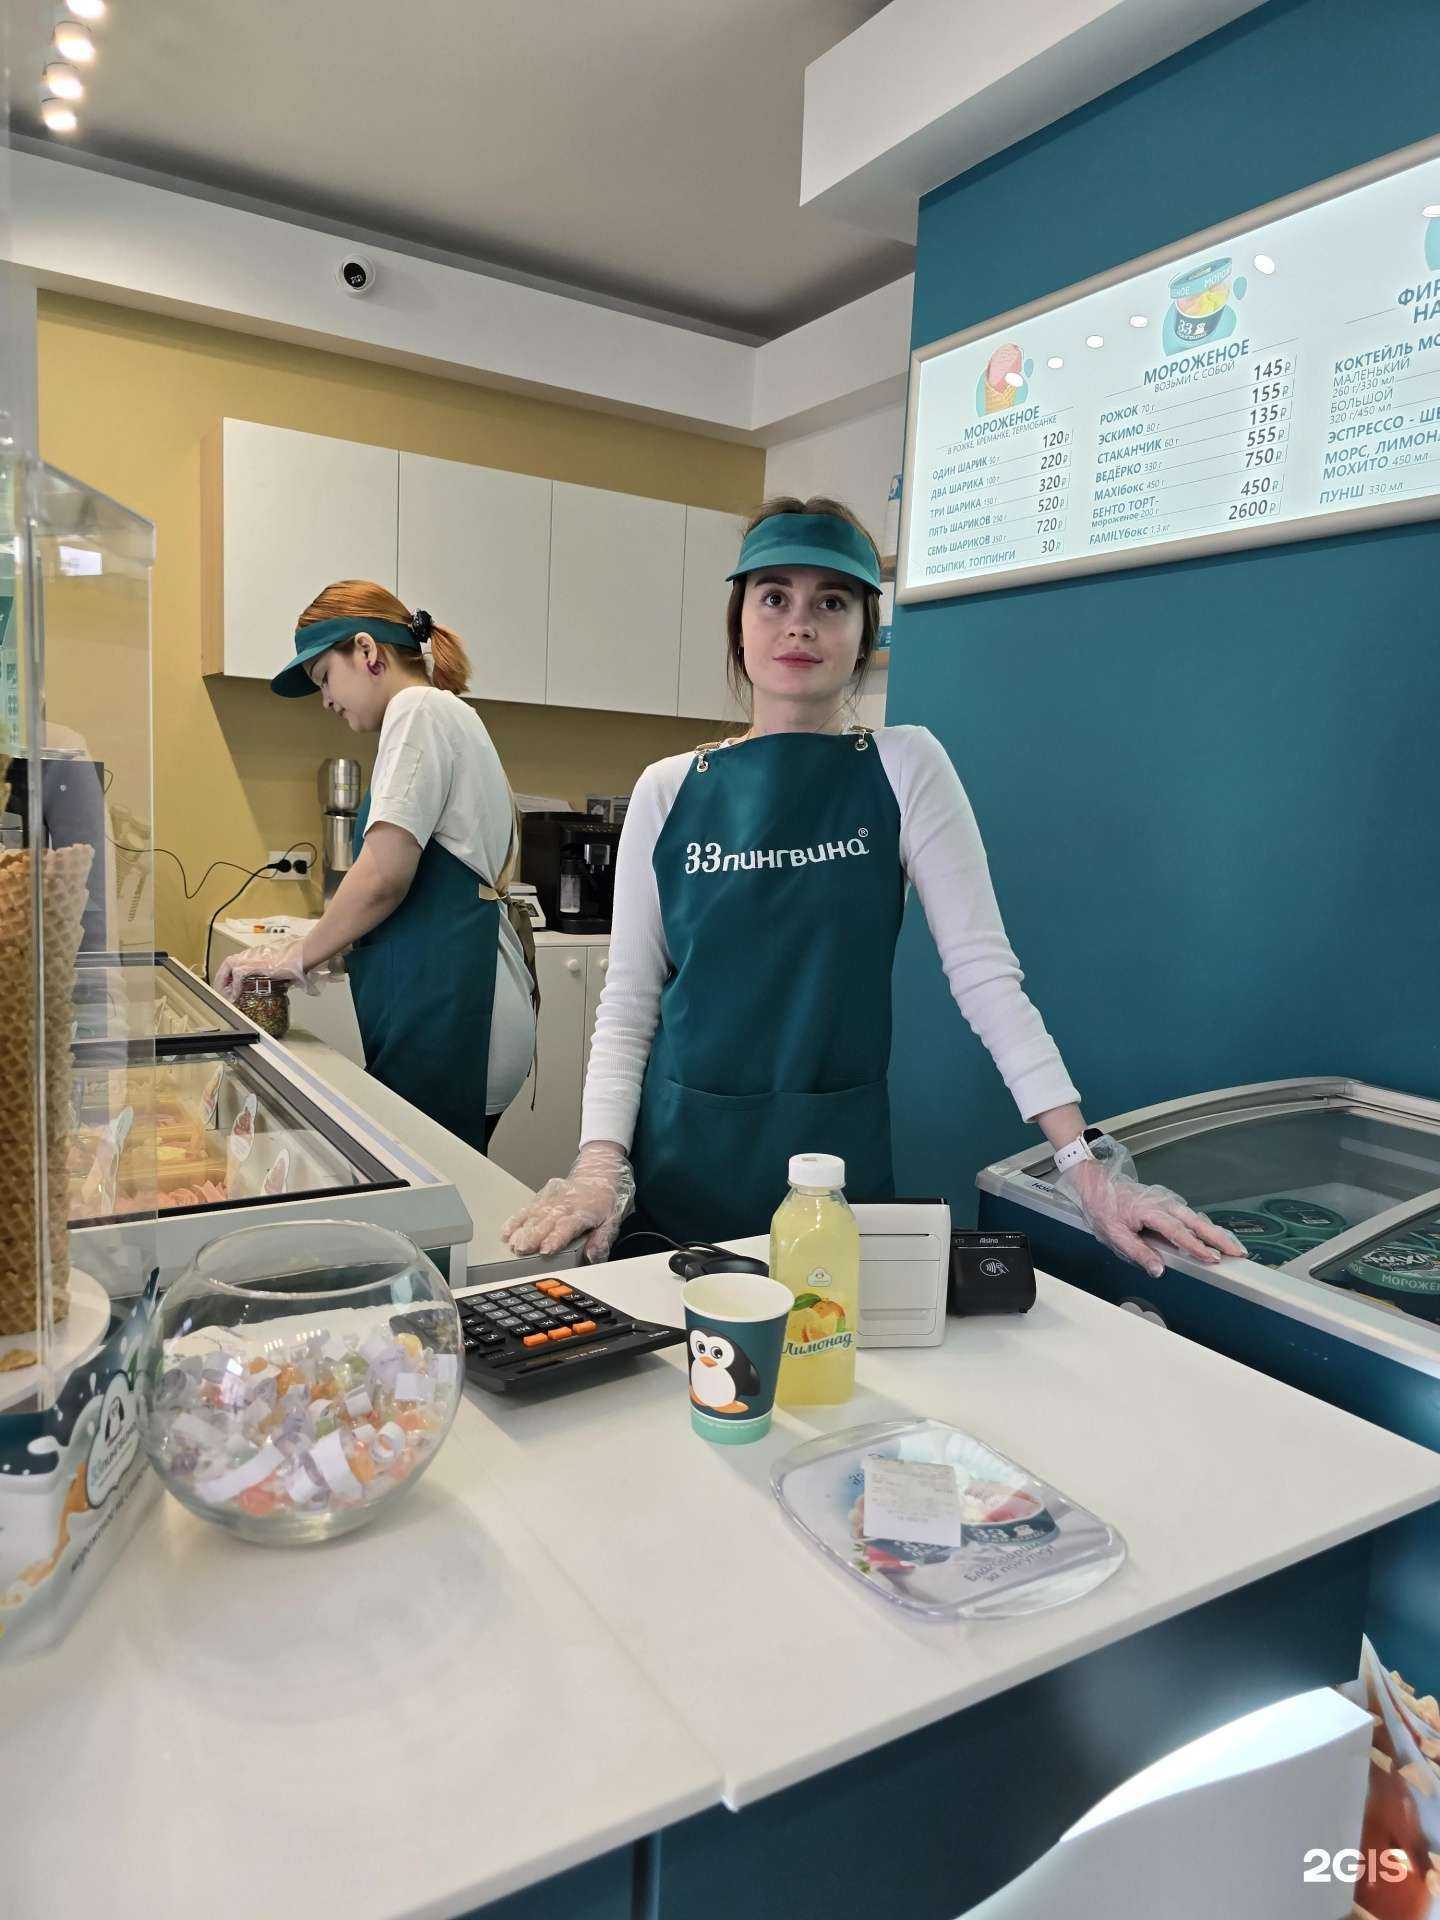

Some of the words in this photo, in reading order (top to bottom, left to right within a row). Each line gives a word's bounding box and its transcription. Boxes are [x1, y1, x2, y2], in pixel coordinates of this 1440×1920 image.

[1143, 338, 1250, 386] МОРОЖЕНОЕ
[1335, 342, 1413, 374] КОКТЕЙЛЬ
[1154, 376, 1191, 393] ВОЗЬМИ
[1202, 360, 1235, 378] СОБОЙ
[1333, 356, 1410, 387] МАЛЕНЬКИЙ
[1332, 384, 1350, 398] 260
[1381, 375, 1395, 386] мл
[1330, 388, 1393, 414] БОЛЬШОЙ
[964, 406, 1040, 440] МОРОЖЕНОЕ
[1100, 405, 1138, 425] РОЖОК
[1329, 412, 1347, 424] 320
[1378, 403, 1392, 412] мл
[1098, 424, 1144, 445] ЭСКИМО
[1328, 415, 1404, 444] ЭСПРЕССО
[1098, 439, 1162, 464] СТАКАНЧИК
[1325, 445, 1370, 465] МОРС,
[1375, 430, 1440, 454] ЛИМОН
[932, 466, 955, 481] ОДИН
[958, 457, 987, 473] ШАРИК
[1096, 462, 1142, 484] ВЕДЁРКО
[1323, 455, 1388, 480] МОХИТО
[1392, 454, 1411, 467] 450
[1414, 452, 1428, 462] мл
[931, 486, 947, 501] ДВА
[949, 478, 984, 494] ШАРИКА
[1320, 484, 1364, 504] ПУНШ
[1368, 483, 1386, 495] 330
[1388, 481, 1403, 492] мл
[930, 507, 945, 518] ТРИ
[947, 498, 981, 514] ШАРИКА
[1092, 503, 1125, 519] БЕНТО
[929, 525, 948, 537] ПЯТЬ
[950, 515, 991, 533] ШАРИКОВ
[927, 543, 947, 557] СЕМЬ
[949, 535, 990, 552] ШАРИКОВ
[926, 561, 966, 577] ПОСЫПКИ,
[968, 550, 1016, 567] ТОППИНГИ
[1382, 1272, 1440, 1291] МОРОЖЕ
[782, 1333, 852, 1356] Лимонад
